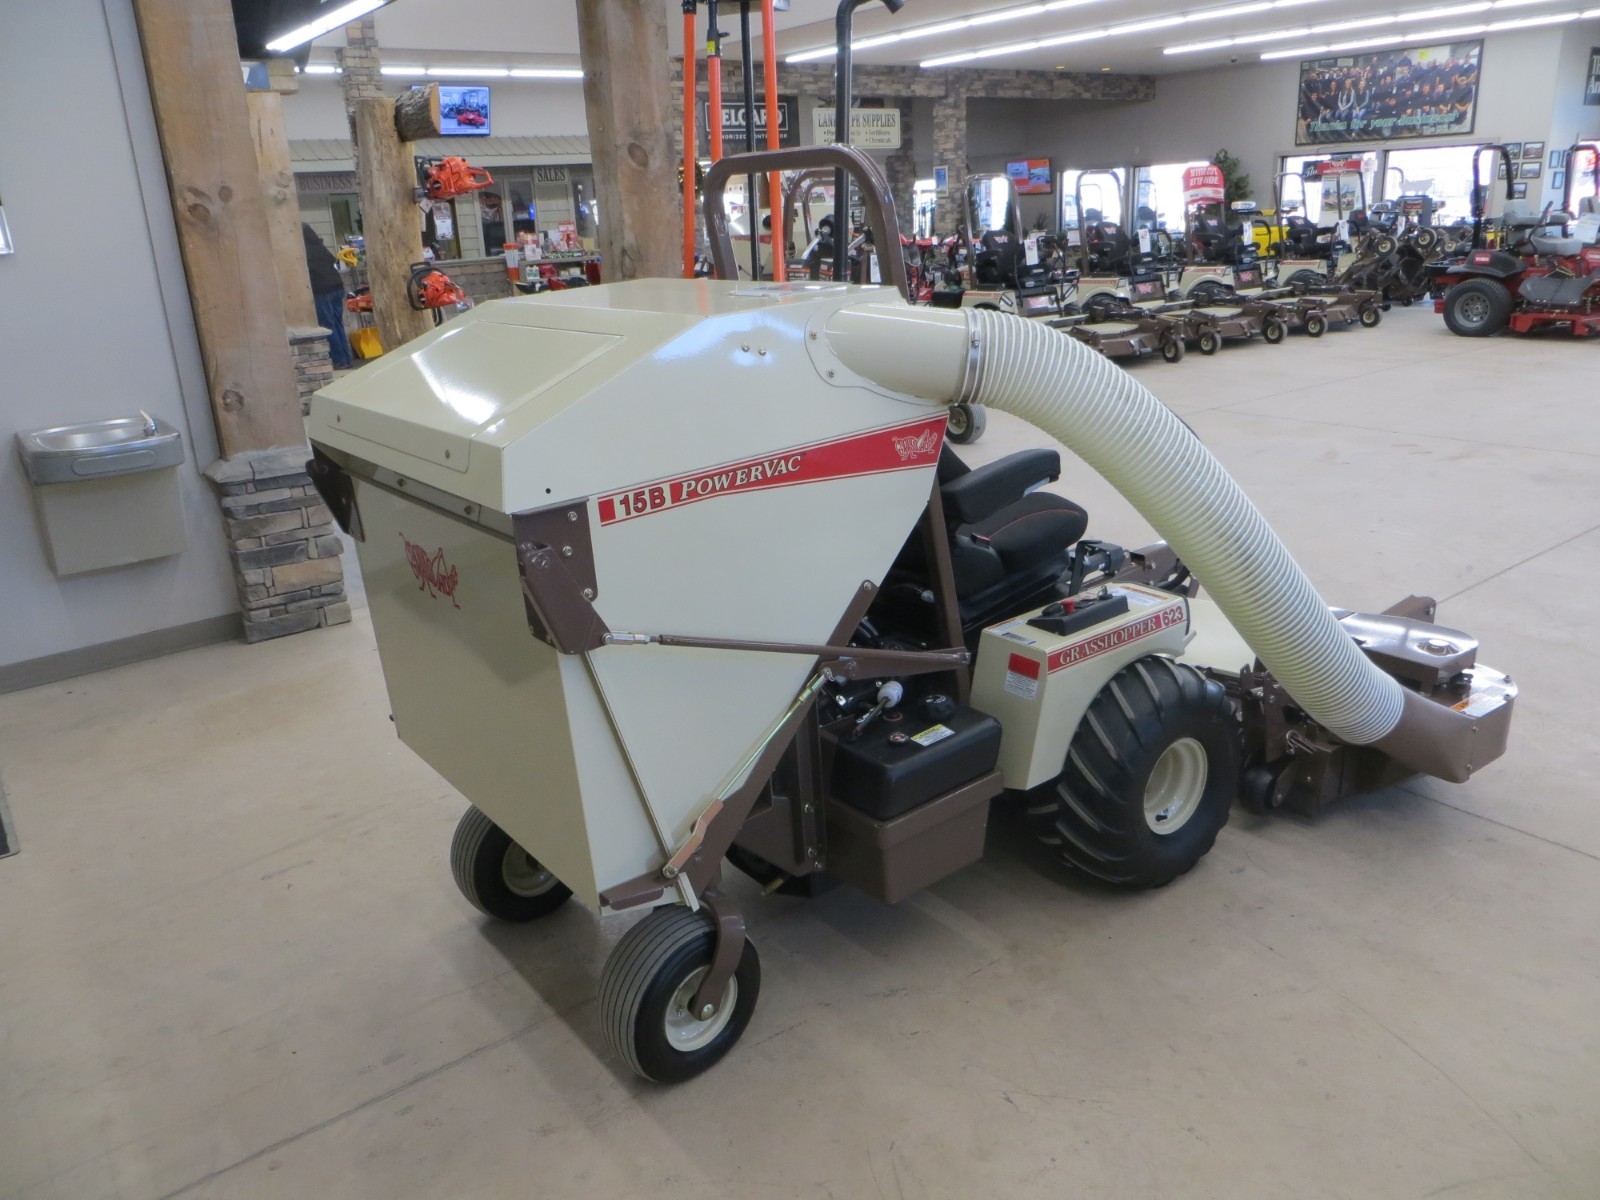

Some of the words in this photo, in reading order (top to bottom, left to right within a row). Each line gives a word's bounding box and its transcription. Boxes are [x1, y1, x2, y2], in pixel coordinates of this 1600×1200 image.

[720, 109, 783, 126] ELGAR
[818, 113, 860, 127] LANPE
[862, 113, 896, 127] SUPPLIES
[299, 174, 352, 191] BUSINESS
[537, 167, 566, 182] SALES
[619, 487, 667, 517] 15B
[1059, 617, 1157, 666] GRASSHOPPER
[1161, 605, 1185, 628] 623
